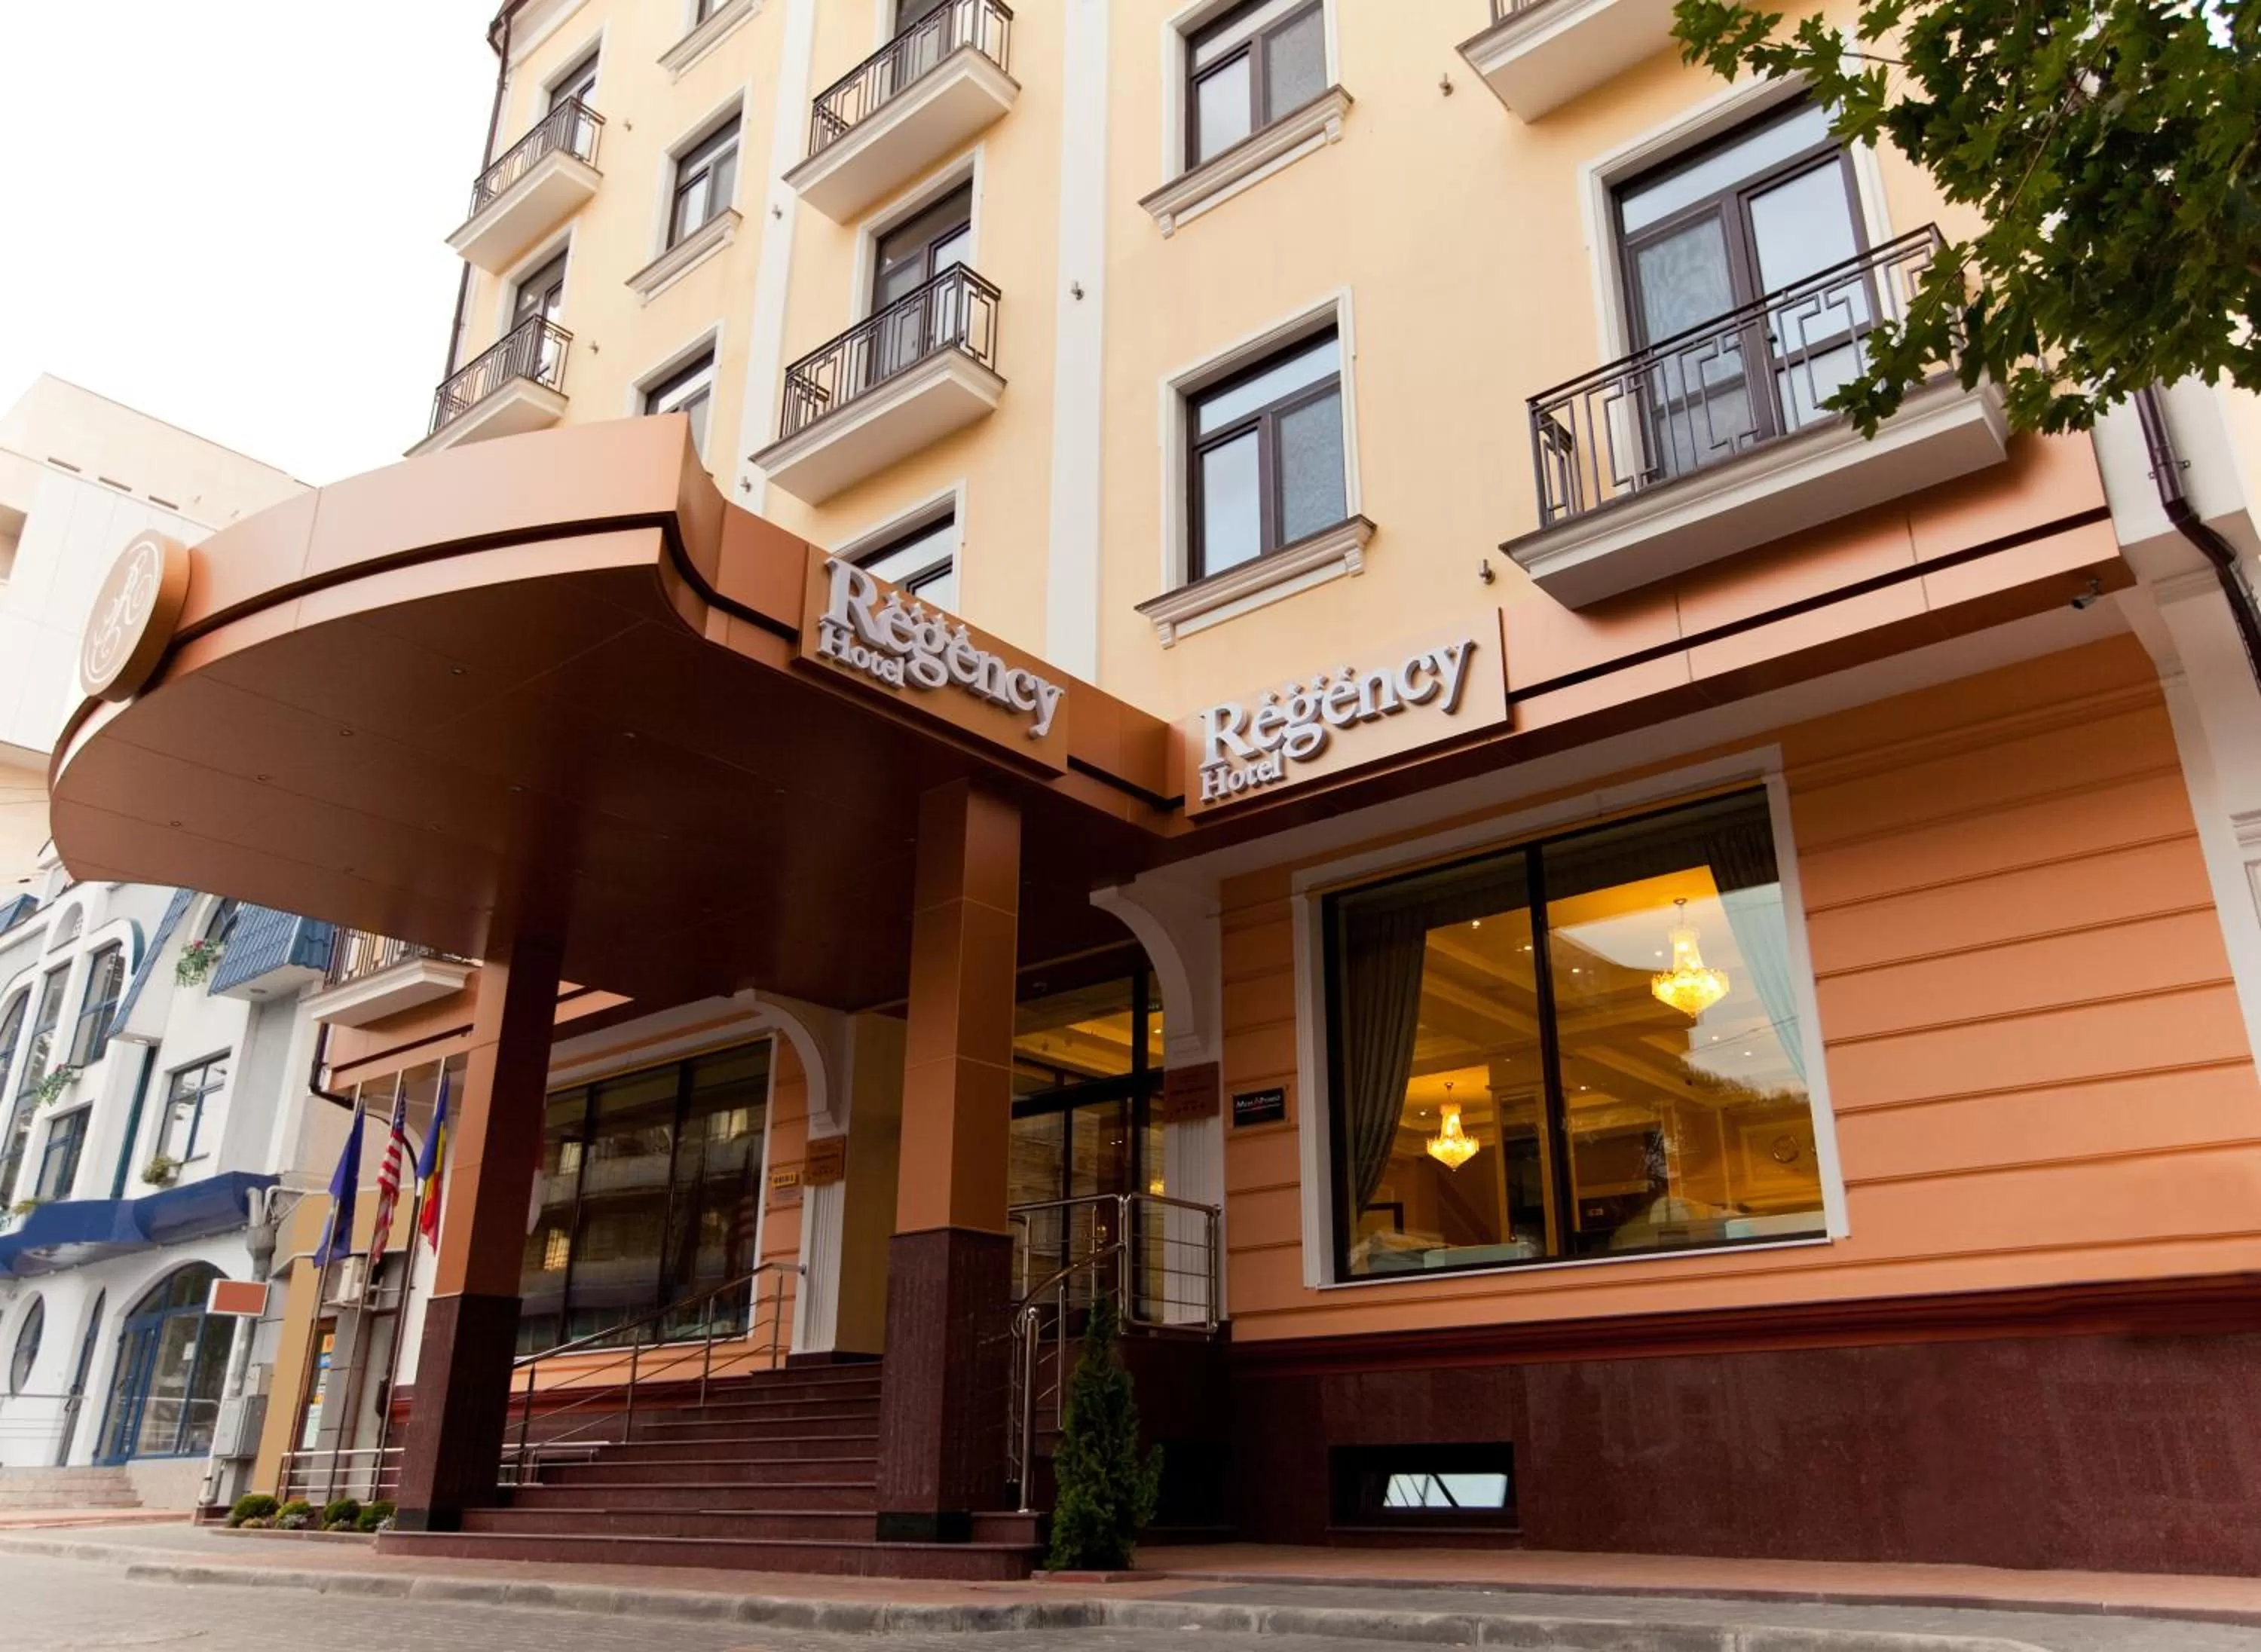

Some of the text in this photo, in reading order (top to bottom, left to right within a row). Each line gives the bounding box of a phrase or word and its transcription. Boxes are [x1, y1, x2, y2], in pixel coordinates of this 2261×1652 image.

[817, 620, 905, 690] Hotel
[824, 556, 1064, 738] Regency
[1199, 638, 1478, 771] Regency
[1199, 750, 1286, 803] Hotel
